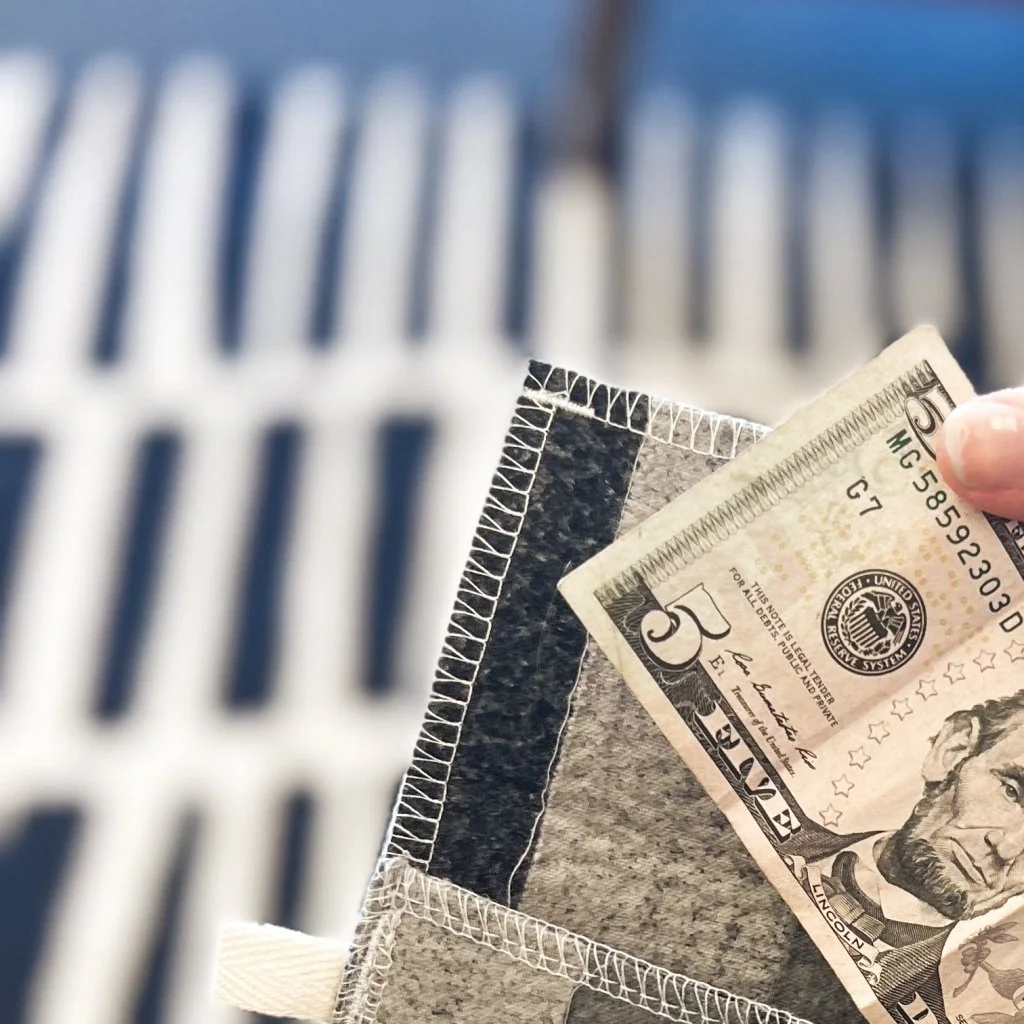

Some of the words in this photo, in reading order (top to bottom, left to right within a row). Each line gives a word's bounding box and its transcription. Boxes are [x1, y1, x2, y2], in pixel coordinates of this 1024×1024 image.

[886, 428, 921, 470] MG
[640, 582, 732, 673] 5
[827, 578, 863, 620] FEDERAL
[874, 575, 913, 601] UNITED
[909, 602, 921, 640] STATES
[729, 567, 746, 588] FOR
[742, 588, 756, 608] ALL
[777, 640, 802, 675] PUBLIC
[799, 675, 816, 695] AND
[812, 694, 839, 728] PRIVATE
[750, 581, 769, 605] THIS
[766, 604, 787, 631] NOTE
[784, 630, 794, 642] IS
[791, 641, 812, 671] LEGAL
[809, 668, 835, 706] TENDER
[827, 625, 858, 667] RESERVE
[862, 649, 908, 671] SYSTEM
[693, 700, 802, 844] FIVE
[812, 884, 865, 949] LINCOLN
